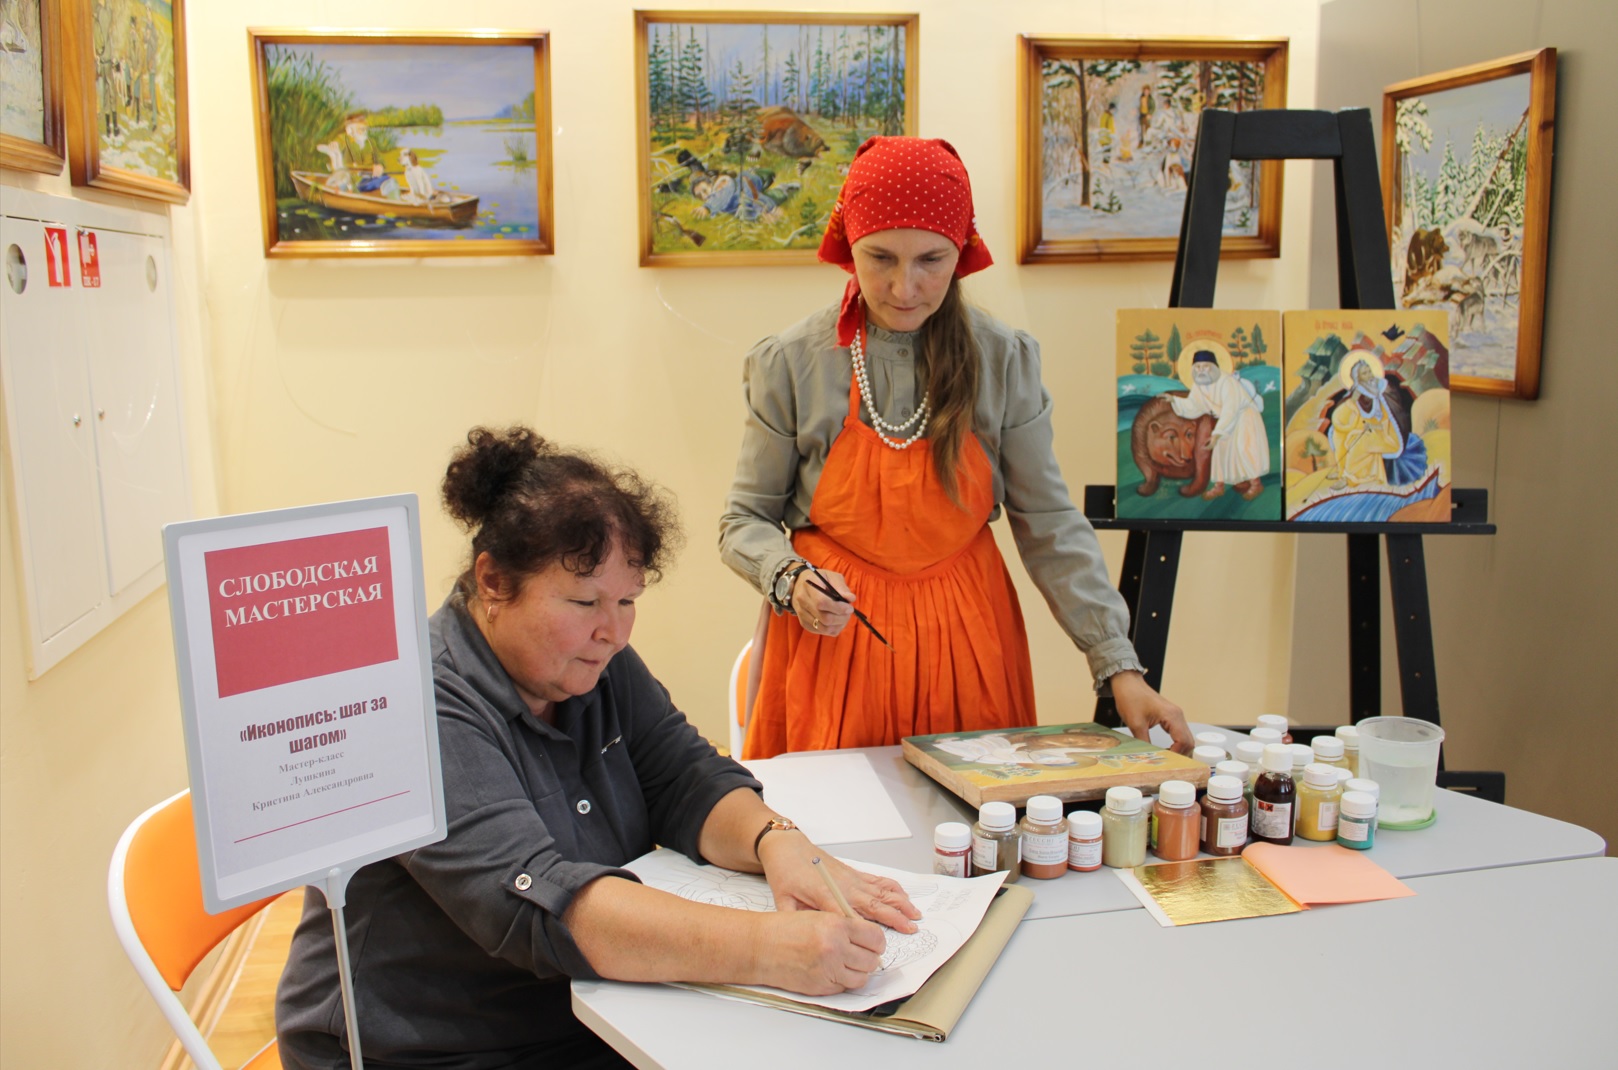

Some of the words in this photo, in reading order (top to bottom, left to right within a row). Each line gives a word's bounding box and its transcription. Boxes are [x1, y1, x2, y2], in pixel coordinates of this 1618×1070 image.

[218, 555, 379, 598] СЛОБОДСКАЯ
[224, 582, 383, 628] МАСТЕРСКАЯ
[240, 708, 337, 743] «Иконопись:
[339, 699, 368, 719] шаг
[370, 696, 388, 711] за
[289, 729, 347, 754] шагом»
[279, 751, 345, 774] Мастер-класс
[290, 767, 336, 786] Лушкина
[252, 791, 301, 812] Кристина
[303, 771, 375, 797] Александровна
